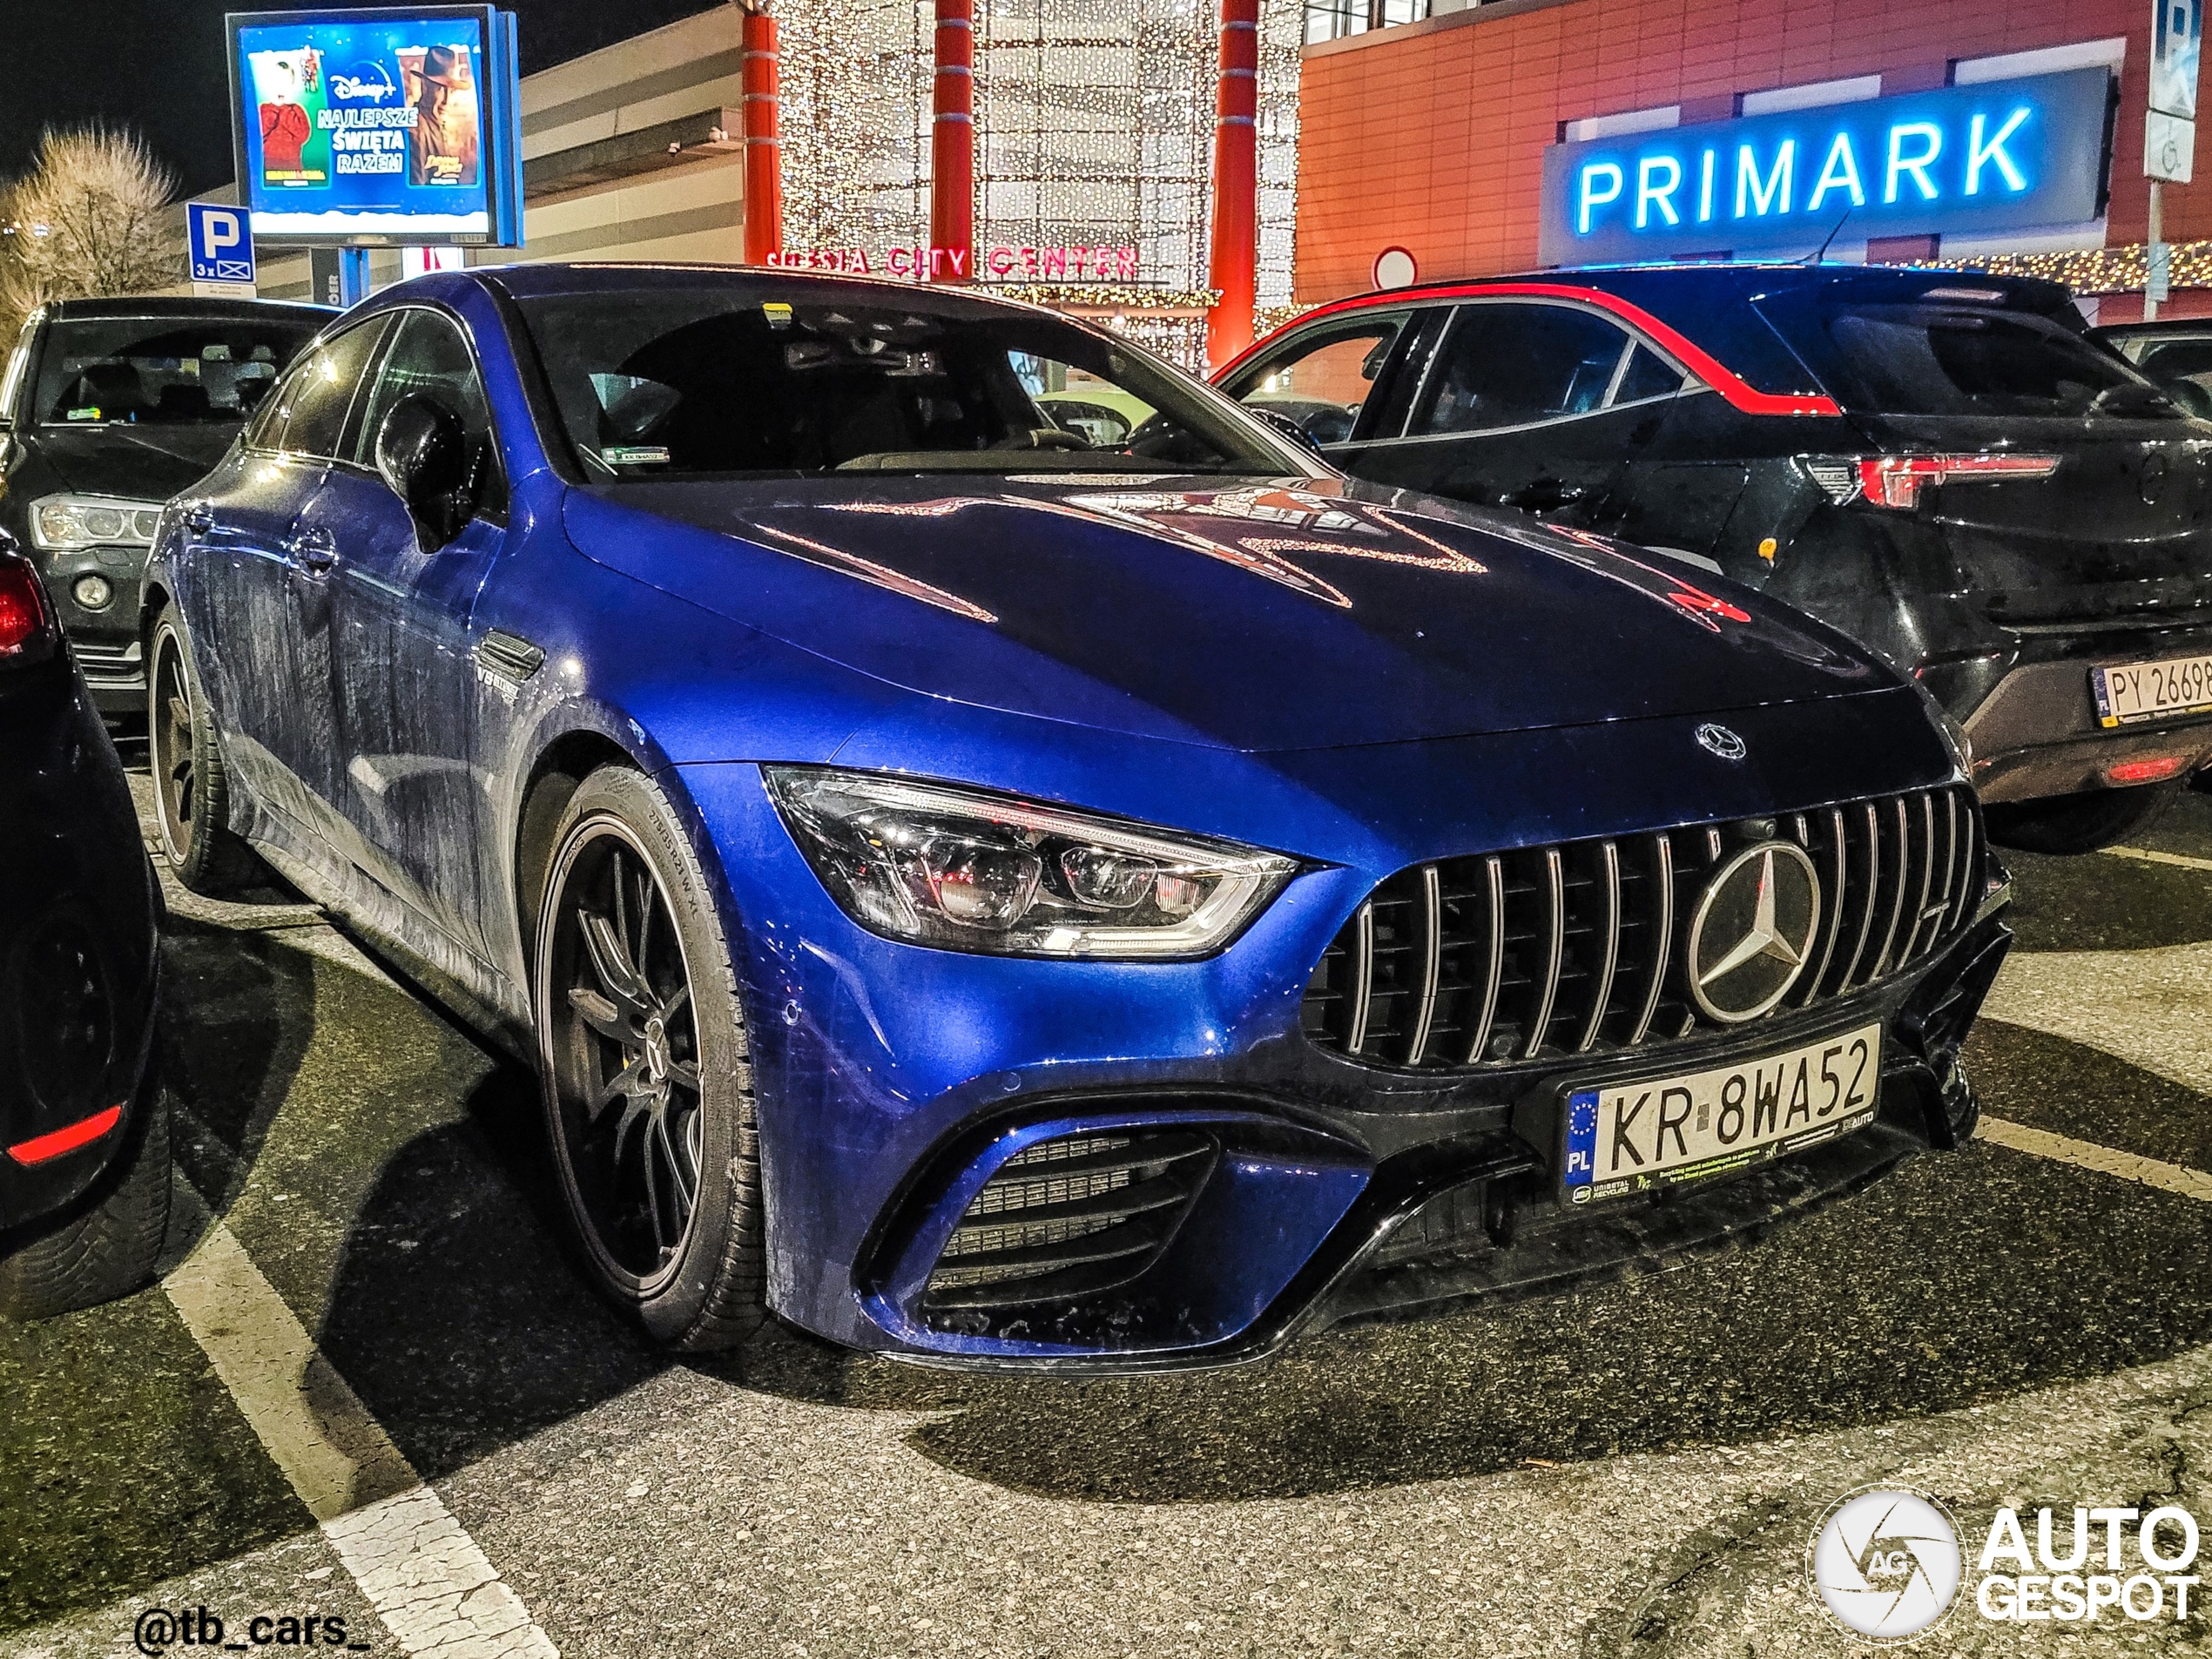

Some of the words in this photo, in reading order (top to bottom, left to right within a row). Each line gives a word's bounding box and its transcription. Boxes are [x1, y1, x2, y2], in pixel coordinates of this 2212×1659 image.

[317, 107, 419, 129] NAJLEPSZE
[332, 127, 405, 154] ŚWIĘTA
[336, 152, 403, 174] RAZEM
[1578, 106, 2031, 234] PRIMARK
[202, 210, 239, 259] P
[766, 248, 868, 273] SILESIA
[887, 247, 967, 275] CITY
[988, 246, 1139, 275] CENTER
[2112, 669, 2141, 711] PY
[2151, 660, 2212, 706] 26698
[1610, 1086, 1693, 1171] KR
[1716, 1038, 1868, 1145] 8WA52
[1568, 1150, 1590, 1174] PL
